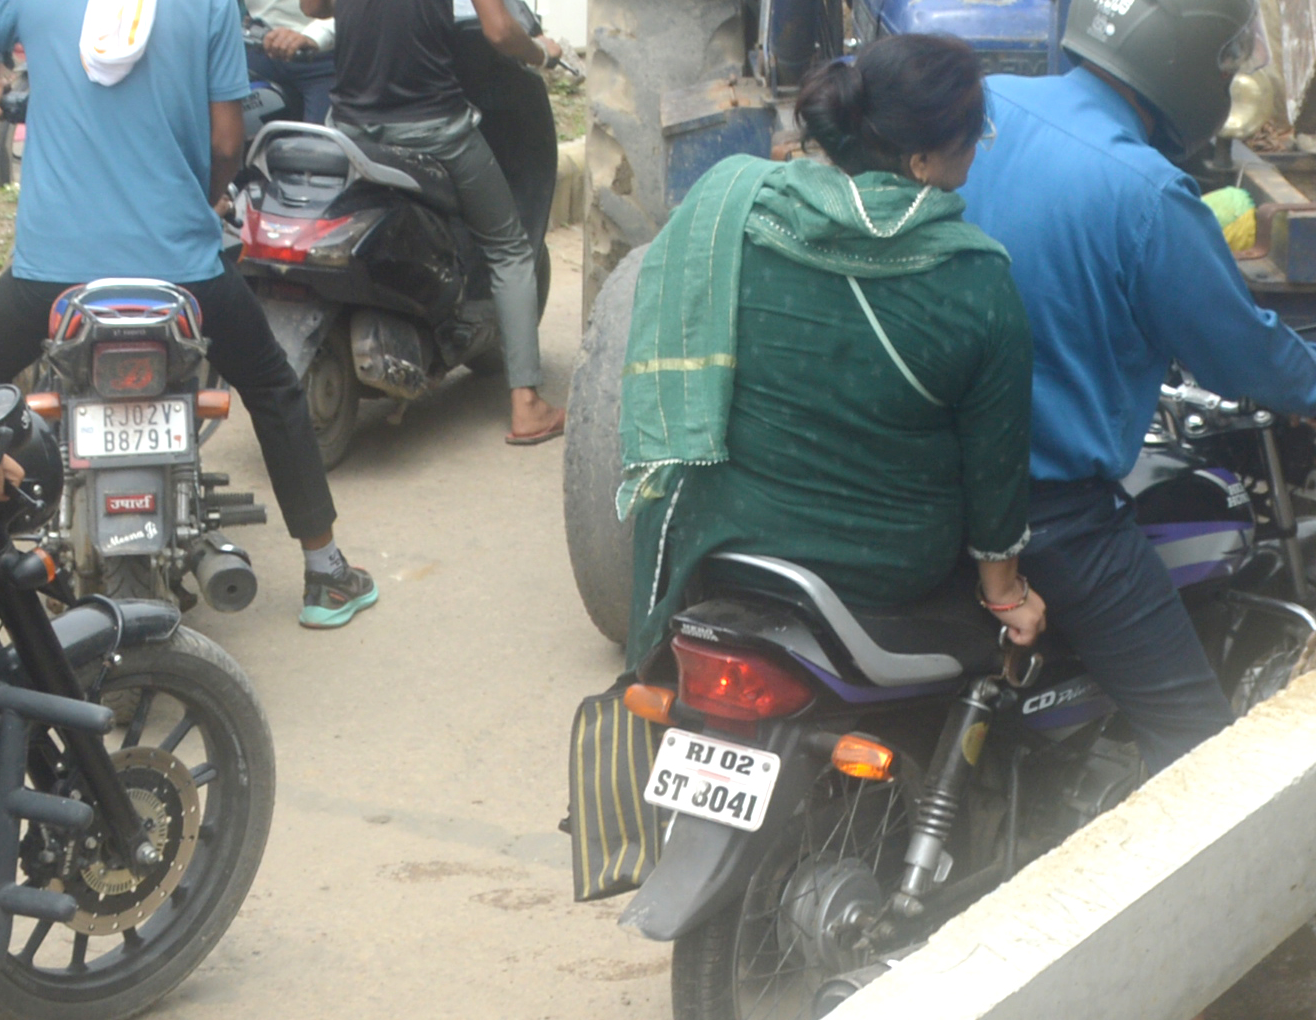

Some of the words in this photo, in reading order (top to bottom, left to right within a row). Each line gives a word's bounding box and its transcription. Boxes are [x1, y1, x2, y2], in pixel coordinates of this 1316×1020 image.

[103, 404, 172, 428] RJ02V
[103, 428, 173, 453] B8791
[1022, 690, 1056, 715] CD
[686, 741, 715, 765] RJ
[720, 750, 755, 776] 02
[653, 769, 690, 801] ST
